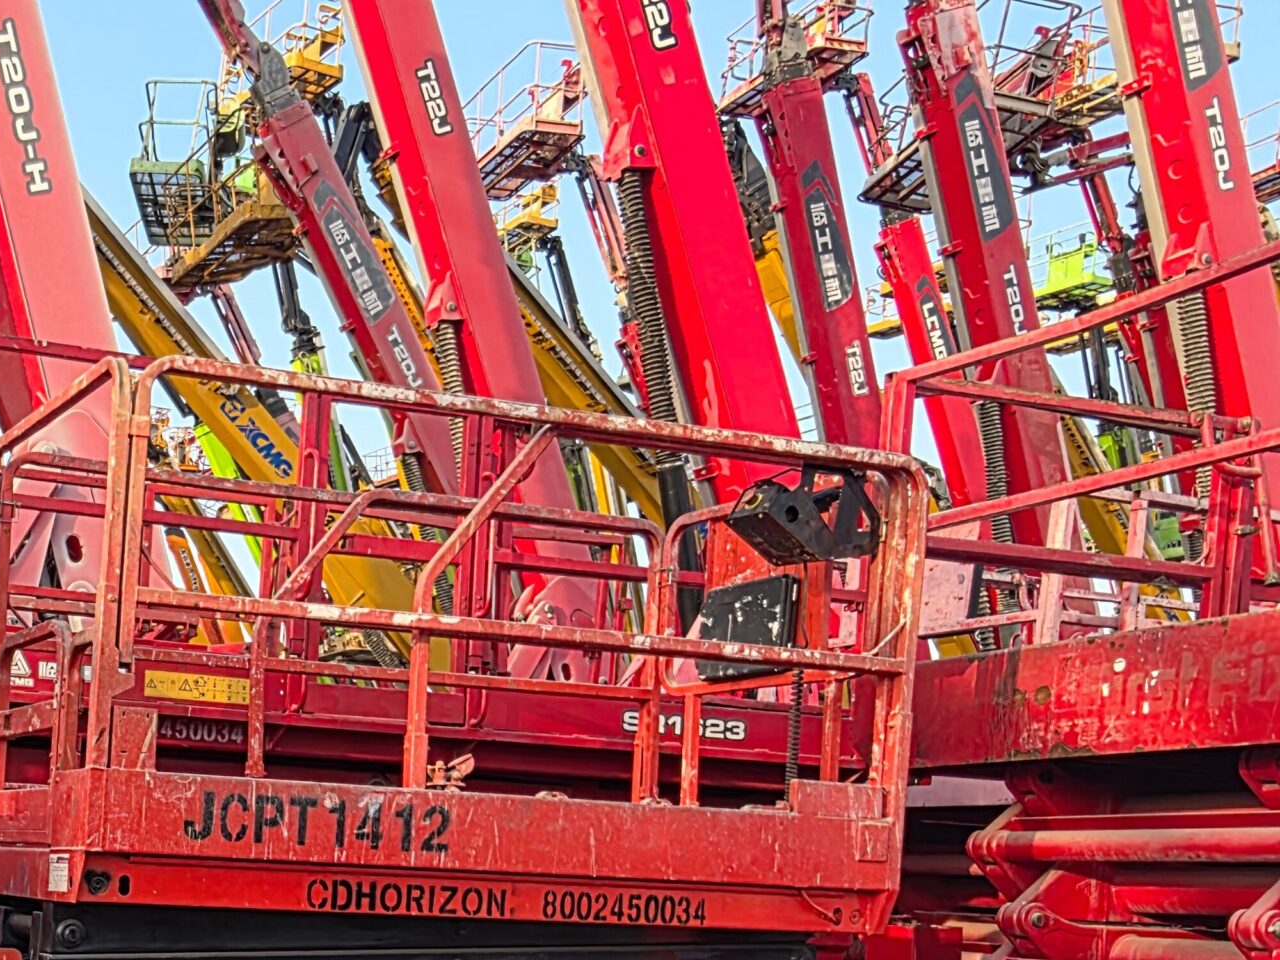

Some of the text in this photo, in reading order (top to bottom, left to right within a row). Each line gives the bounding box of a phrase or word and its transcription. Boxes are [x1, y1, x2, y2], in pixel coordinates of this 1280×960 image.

[642, 0, 677, 49] 2J
[416, 60, 453, 135] T22J
[1205, 97, 1234, 191] T20J
[1003, 264, 1028, 336] T20J
[386, 324, 423, 389] T20J
[846, 340, 870, 397] T22J
[235, 416, 293, 479] XCMG
[160, 719, 244, 745] 450034
[622, 710, 746, 741] S123
[183, 790, 451, 853] JCPT1412
[542, 889, 707, 926] 8002450034
